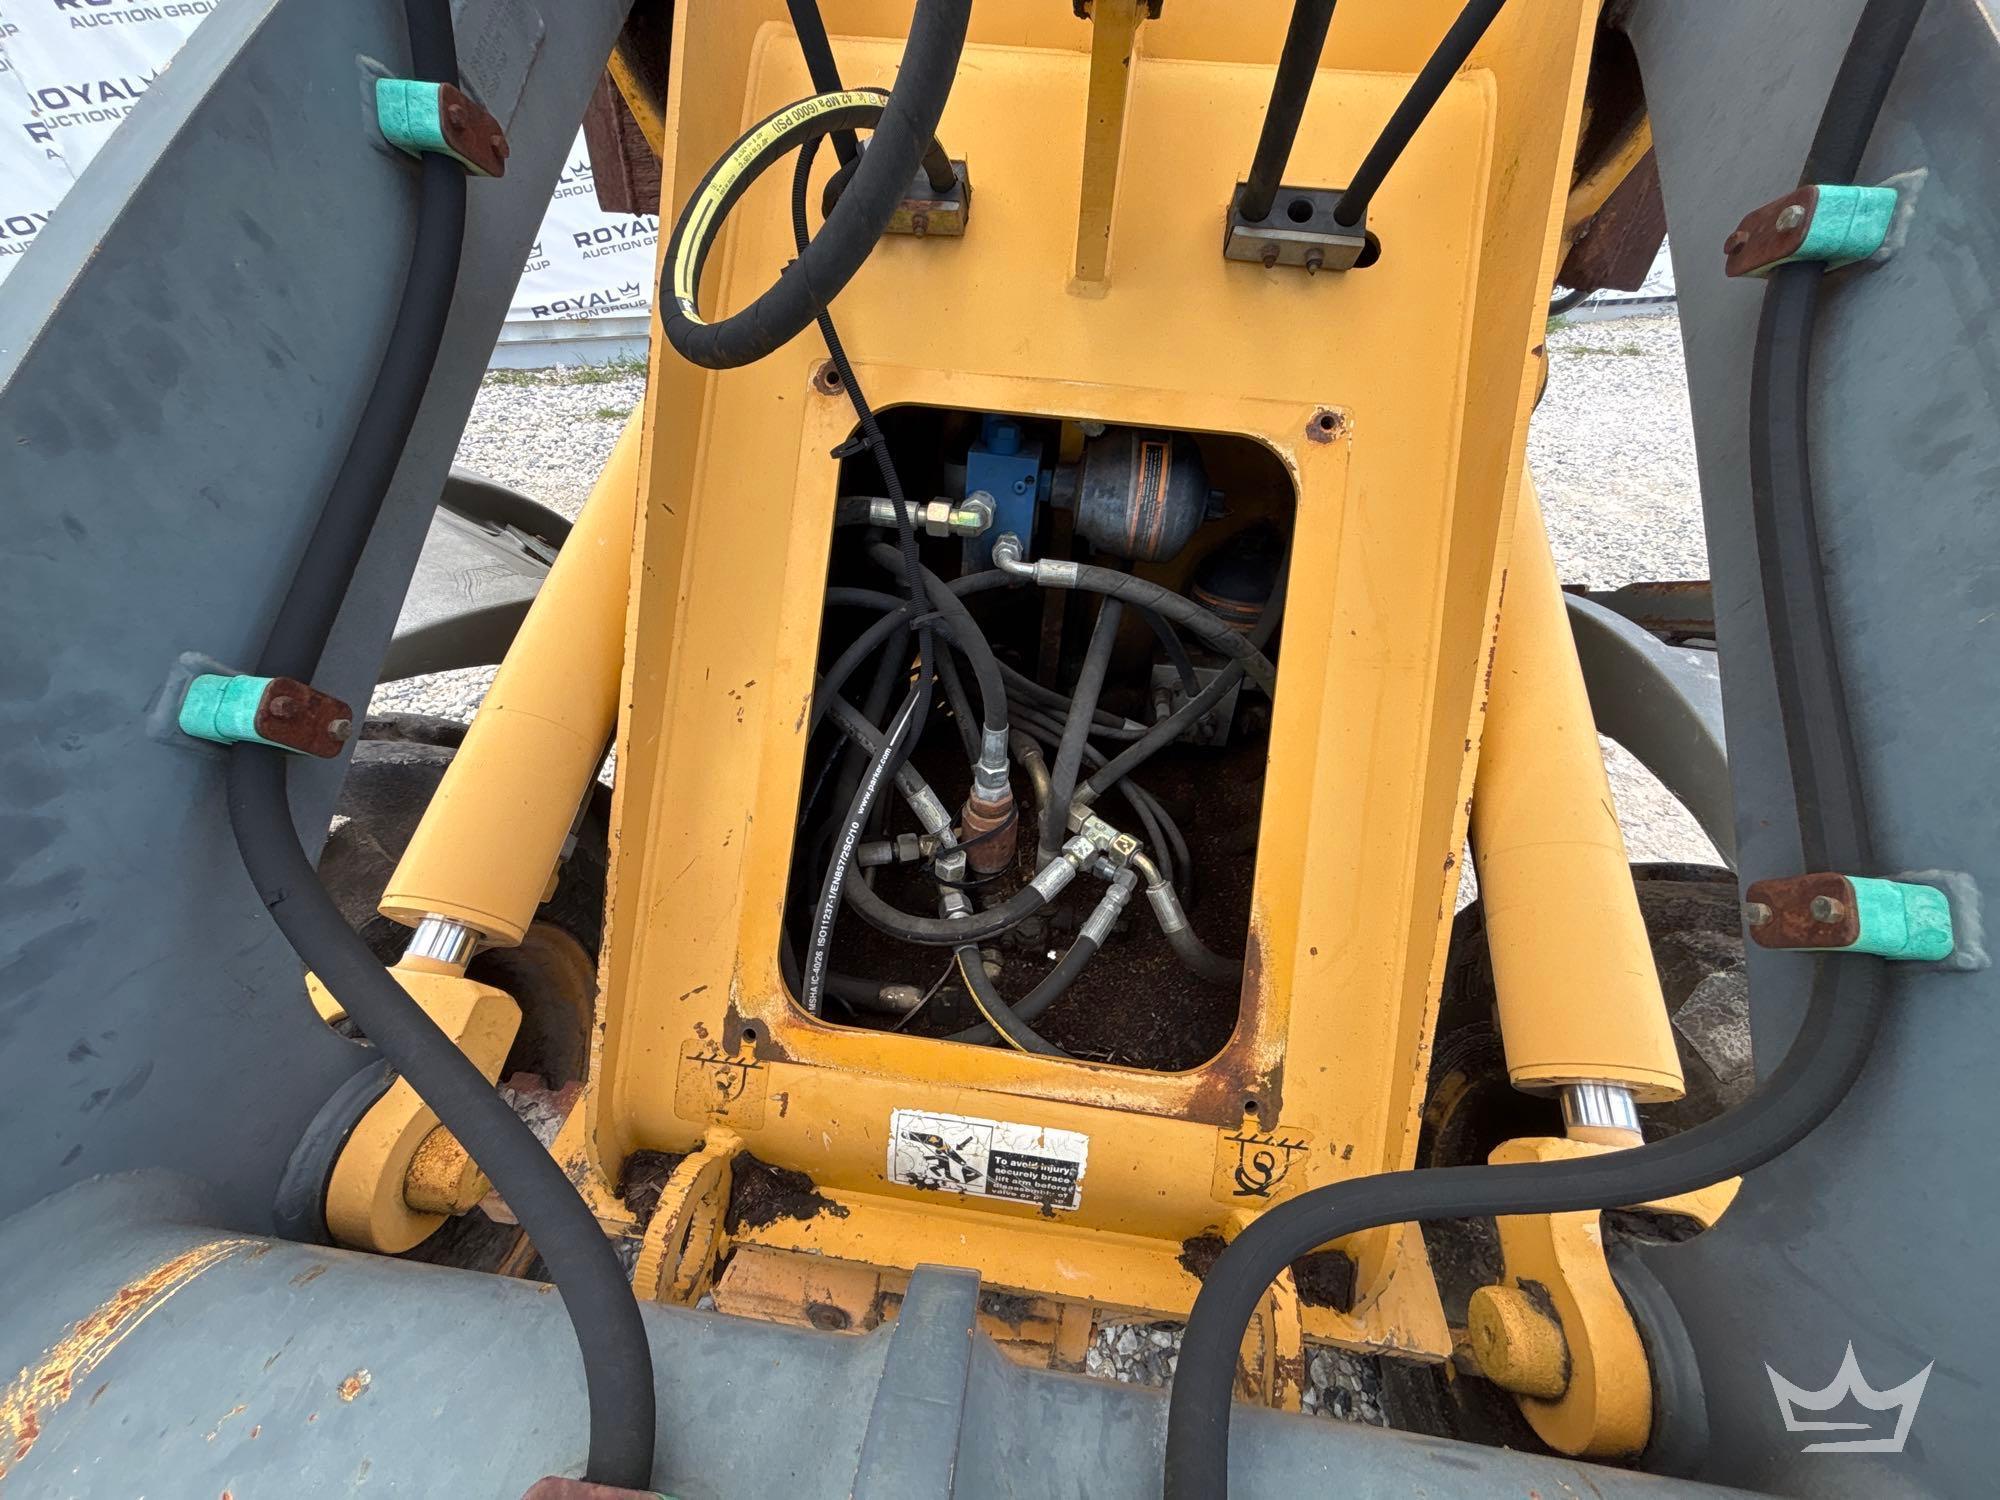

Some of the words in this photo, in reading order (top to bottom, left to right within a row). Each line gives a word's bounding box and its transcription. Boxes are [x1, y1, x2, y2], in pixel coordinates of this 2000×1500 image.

[70, 8, 162, 30] AUCTION
[27, 77, 145, 112] OYAL
[818, 96, 840, 109] MPa
[839, 93, 852, 104] 42
[44, 107, 121, 130] UCTION
[792, 103, 818, 121] (6000
[771, 115, 793, 134] PSI)
[553, 183, 594, 199] GROU
[572, 217, 659, 248] ROYAL
[582, 239, 642, 260] AUCTION
[531, 289, 621, 319] ROYAL
[601, 299, 647, 313] GROUP
[808, 985, 818, 1011] MSHA
[857, 747, 892, 815] www.parker.com
[994, 1156, 1008, 1165] To
[1010, 1159, 1039, 1170] avoid
[994, 1167, 1039, 1180] securely
[1040, 1173, 1071, 1184] brace
[995, 1175, 1009, 1184] lift
[1011, 1177, 1031, 1187] arm
[1034, 1181, 1068, 1192] before
[991, 1189, 1018, 1197] valve
